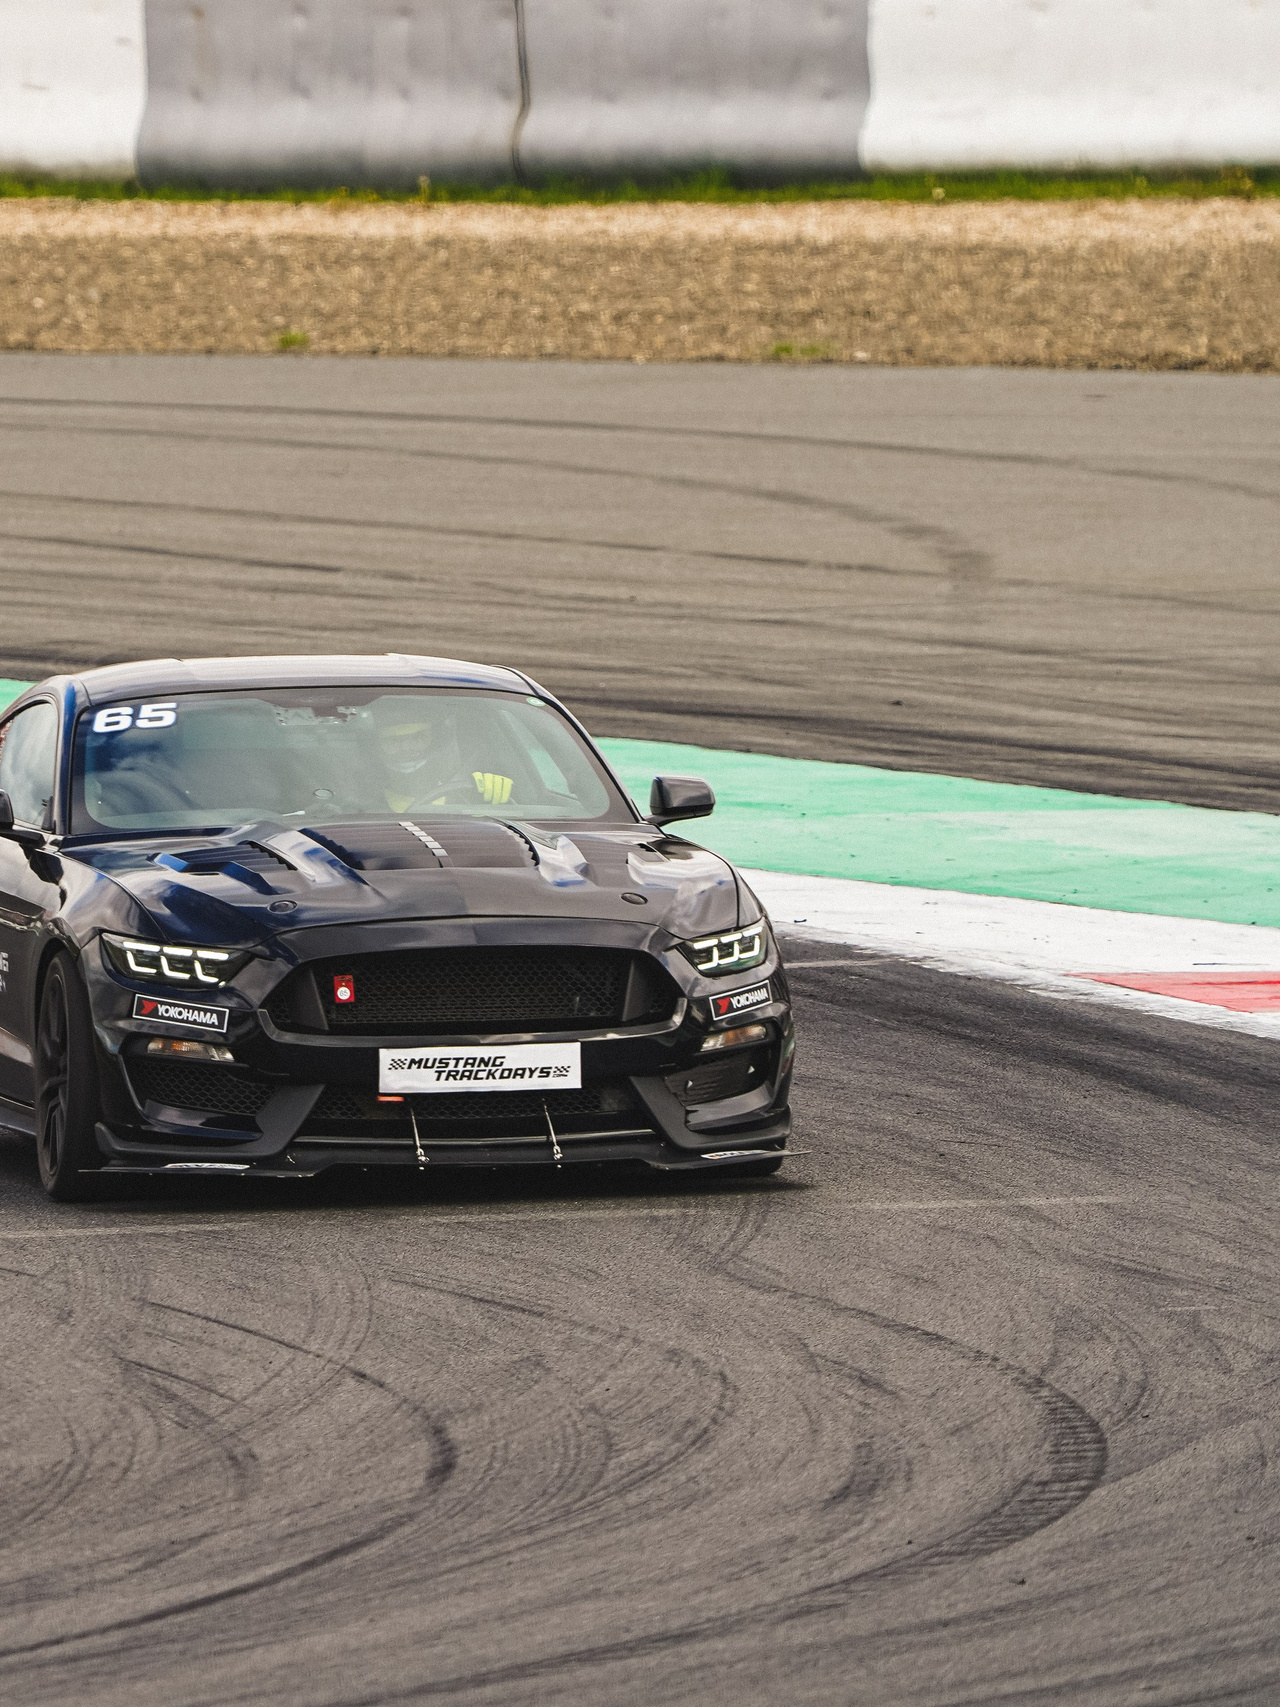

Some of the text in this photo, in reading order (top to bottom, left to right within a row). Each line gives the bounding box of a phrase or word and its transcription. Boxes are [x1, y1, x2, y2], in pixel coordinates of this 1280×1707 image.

[93, 703, 177, 733] 65
[730, 987, 769, 1009] YOKOHAMA
[157, 1003, 219, 1026] YOKOHAMA
[407, 1056, 506, 1070] MUSTANG
[434, 1066, 552, 1082] TRACKDAYS
